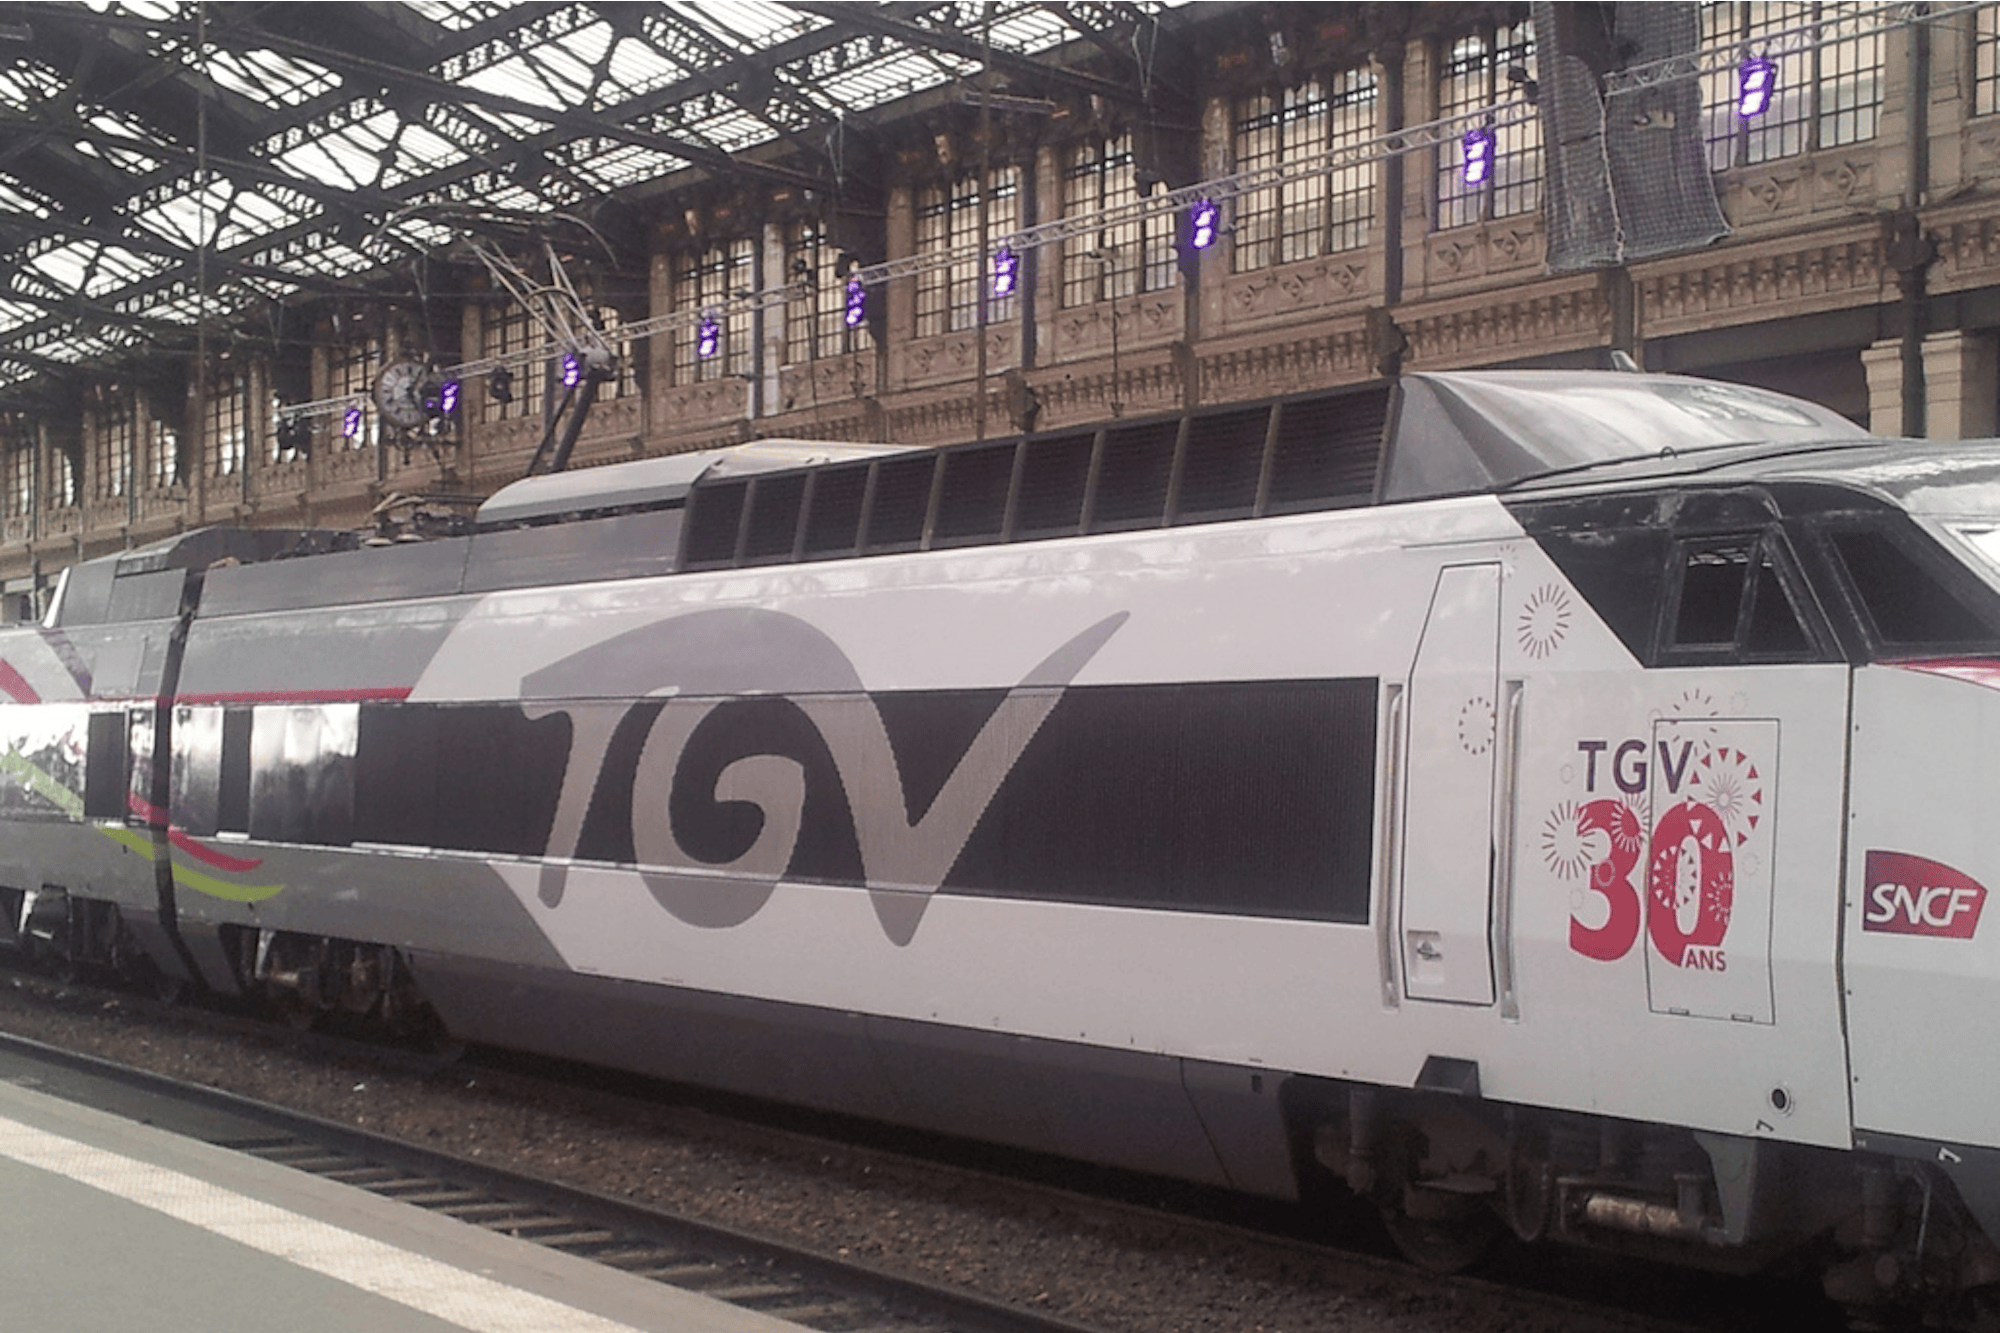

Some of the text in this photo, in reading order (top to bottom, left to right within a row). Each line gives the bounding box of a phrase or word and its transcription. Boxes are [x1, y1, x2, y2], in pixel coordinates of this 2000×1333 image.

[520, 606, 1130, 947] TGV
[1578, 740, 1694, 794] TGV
[1568, 799, 1734, 966] 30
[1867, 884, 1977, 926] SNCF
[1684, 948, 1727, 972] ANS
